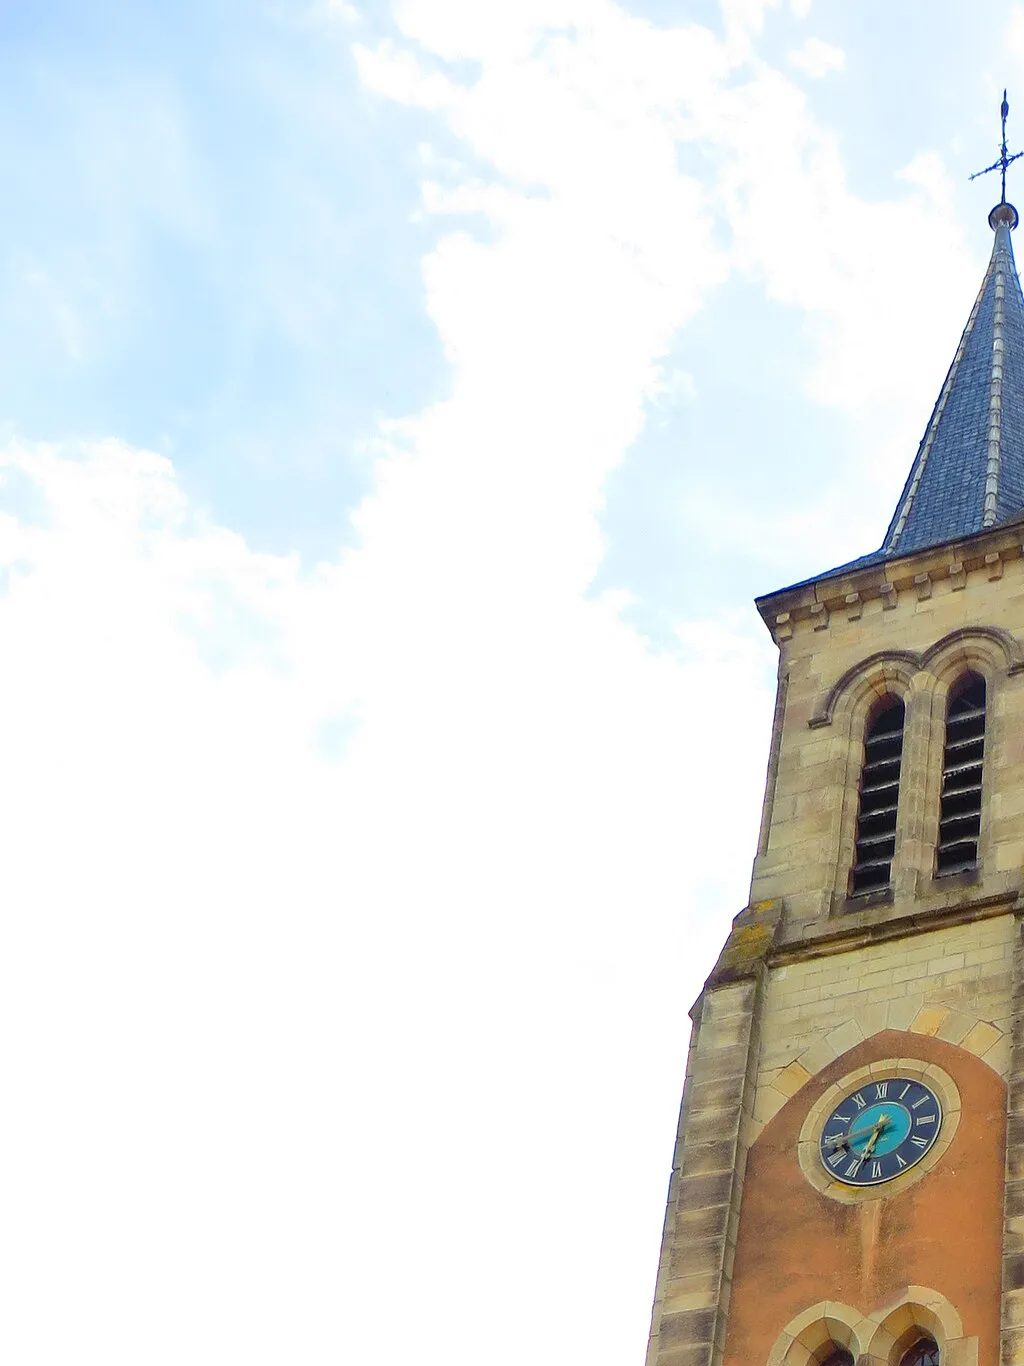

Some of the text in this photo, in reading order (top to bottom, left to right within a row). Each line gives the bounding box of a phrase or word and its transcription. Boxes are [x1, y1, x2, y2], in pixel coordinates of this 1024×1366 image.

[875, 1082, 888, 1100] XII
[899, 1084, 911, 1100] I
[852, 1093, 867, 1110] XI
[911, 1095, 930, 1110] II
[833, 1113, 851, 1123] X
[916, 1114, 936, 1126] III
[911, 1135, 929, 1149] IV
[896, 1153, 907, 1168] V
[871, 1161, 882, 1178] VI
